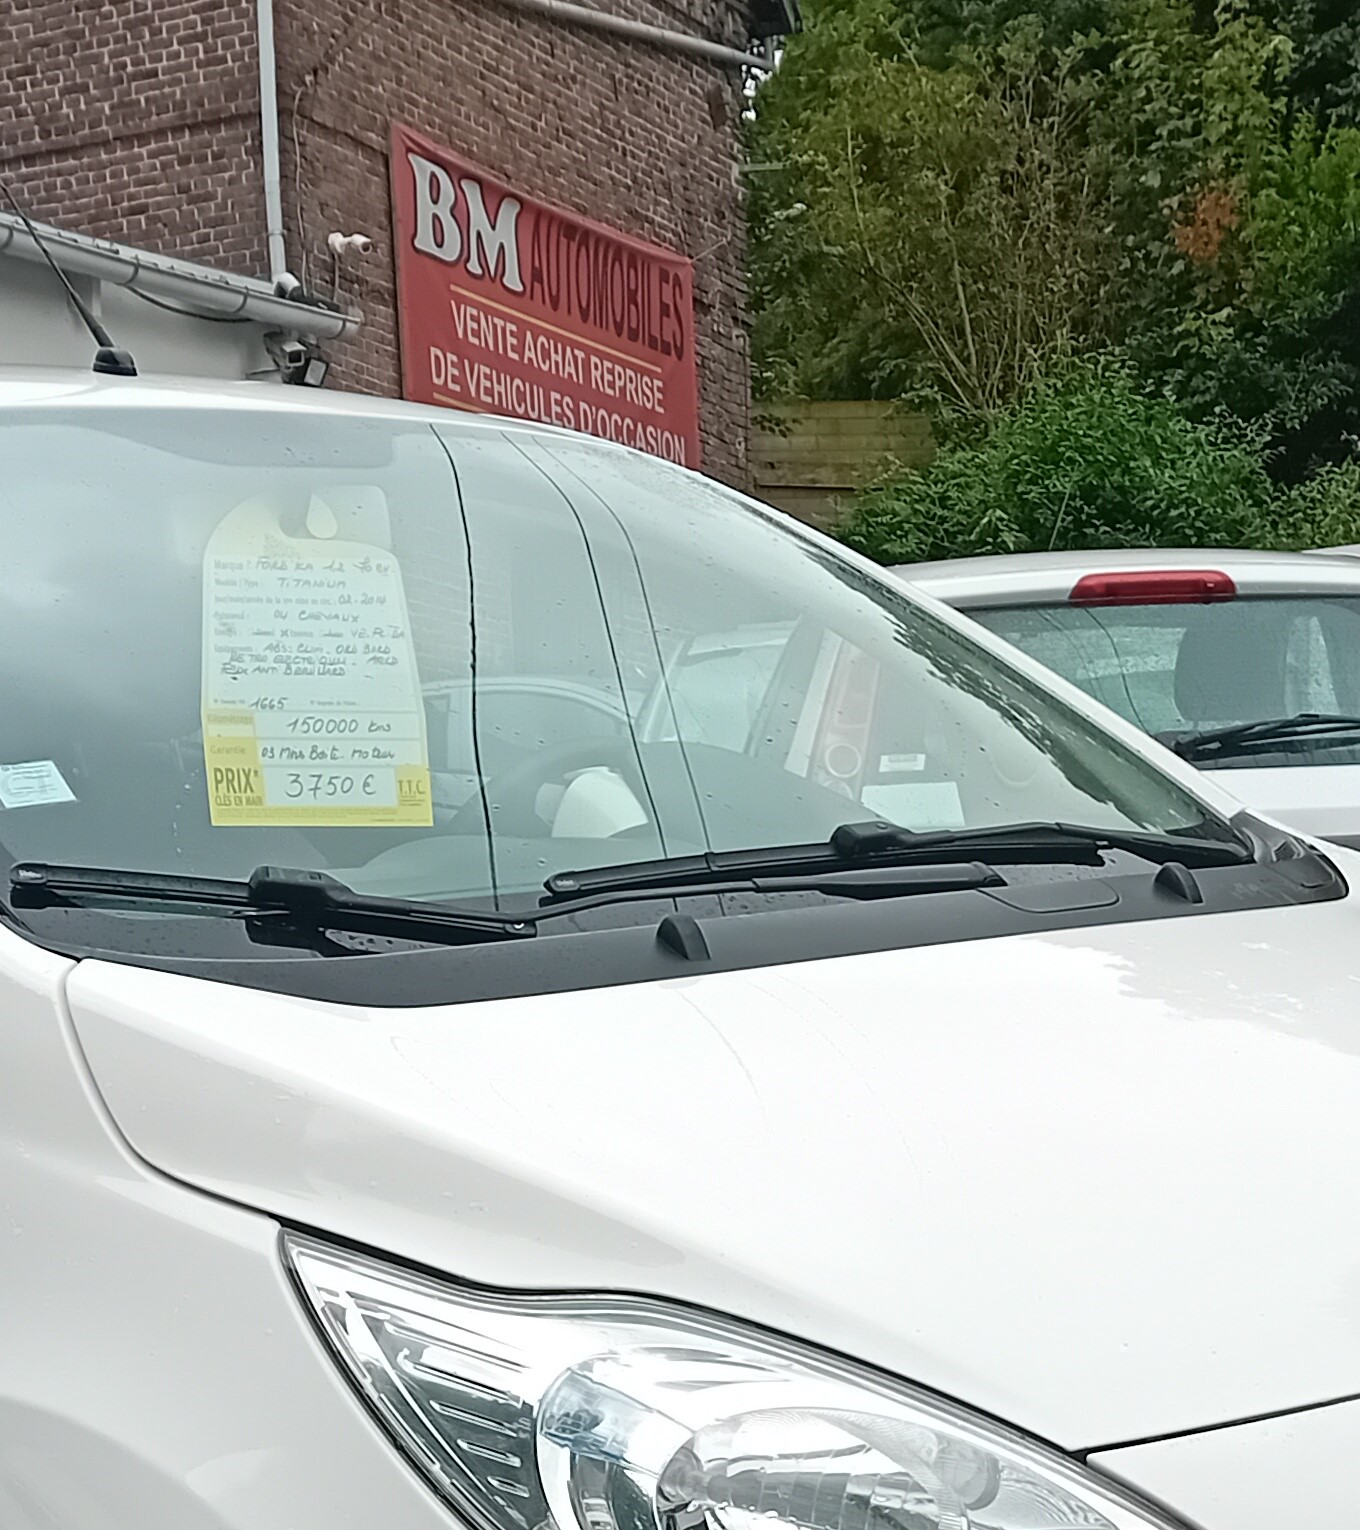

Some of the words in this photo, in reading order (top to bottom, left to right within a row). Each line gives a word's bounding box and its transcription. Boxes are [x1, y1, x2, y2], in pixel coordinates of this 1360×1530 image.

[407, 151, 525, 293] BM
[529, 218, 685, 362] AUTOMOBILES
[430, 346, 461, 394] DE
[464, 360, 575, 430] VEHICULES
[579, 400, 686, 466] D'OCCASION
[450, 300, 521, 361] VENTE
[523, 330, 585, 386] ACHAT
[590, 357, 665, 414] REPRISE
[286, 716, 359, 735] 150000
[285, 772, 354, 801] 3750
[361, 773, 377, 796] €
